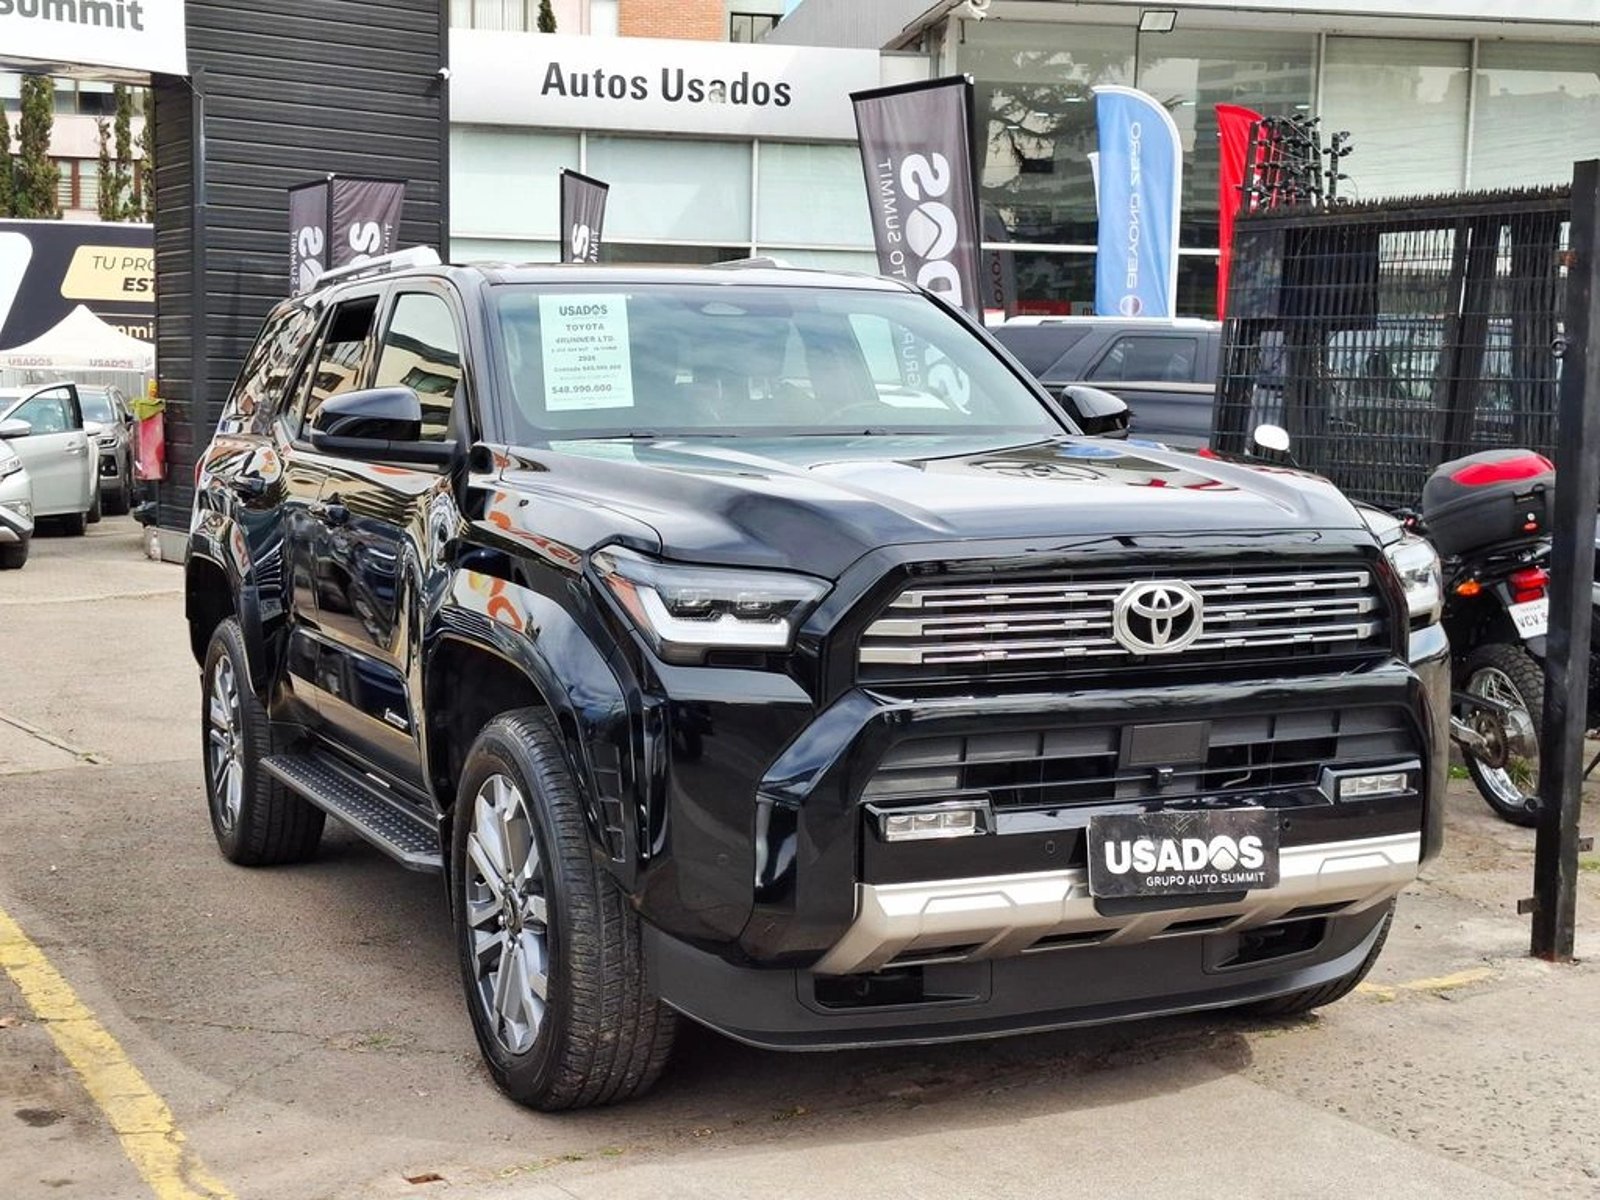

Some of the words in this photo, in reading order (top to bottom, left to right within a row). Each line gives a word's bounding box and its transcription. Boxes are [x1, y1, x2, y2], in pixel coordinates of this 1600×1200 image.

[541, 62, 648, 100] Autos
[662, 68, 791, 107] Usados
[93, 256, 116, 270] TU
[559, 304, 608, 316] USADOS
[566, 323, 605, 331] TOYOTA
[1105, 835, 1264, 874] USADOS
[1146, 875, 1185, 887] GRUPO
[1187, 874, 1218, 885] AUTO
[1221, 872, 1265, 883] SUMMIT
